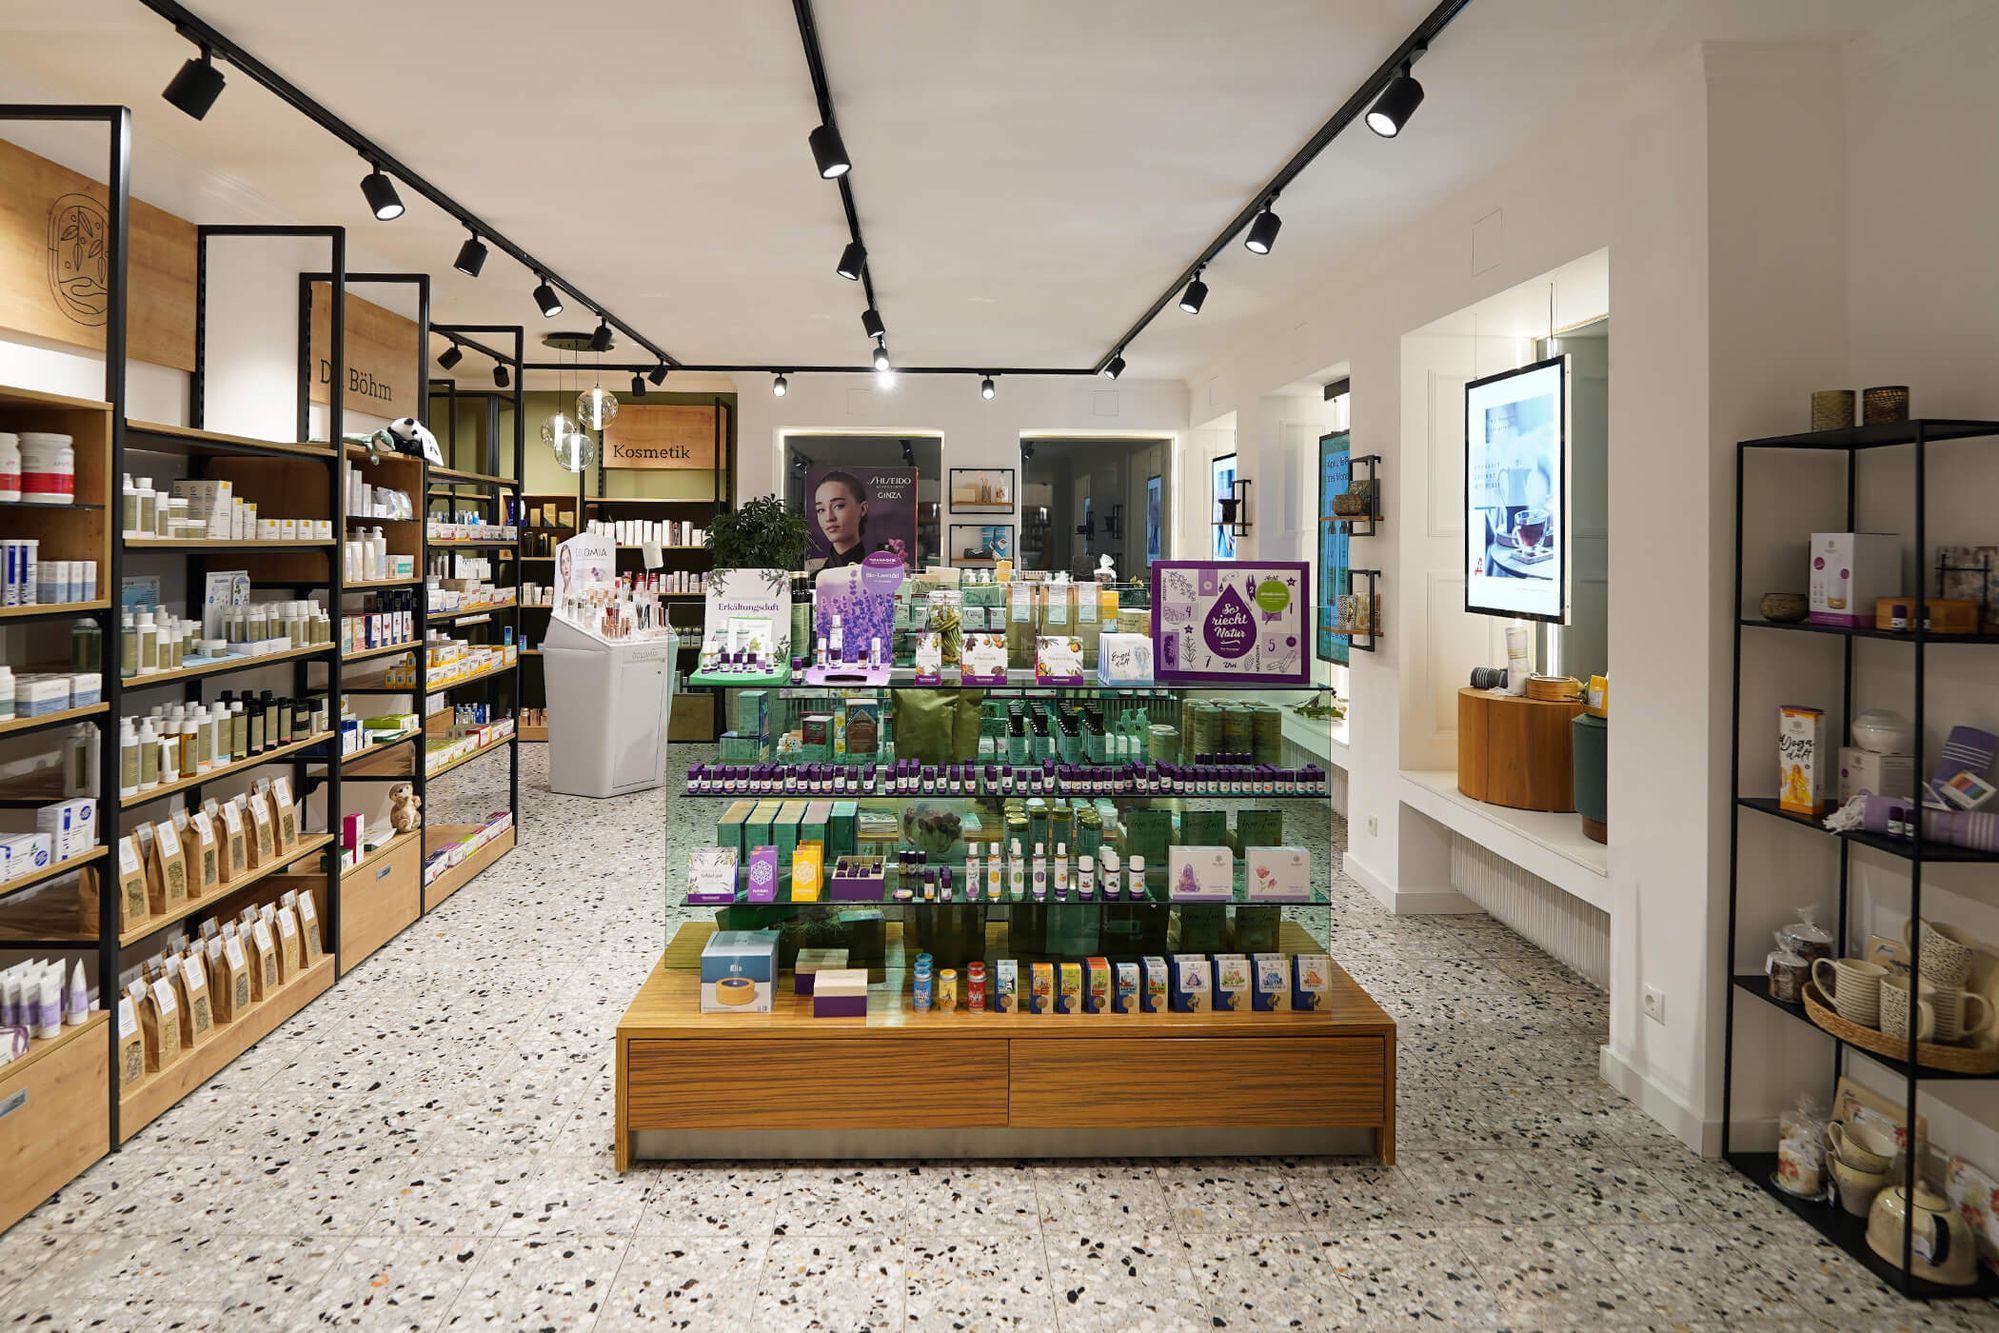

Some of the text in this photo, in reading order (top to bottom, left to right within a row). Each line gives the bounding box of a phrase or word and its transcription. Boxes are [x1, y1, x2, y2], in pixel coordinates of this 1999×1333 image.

[349, 368, 393, 401] Böhm
[613, 444, 691, 459] Kosmetik
[867, 475, 912, 485] SHISEIDO
[877, 491, 902, 499] GINZA
[718, 602, 779, 613] Erkältungsduft
[1185, 605, 1192, 618] 4
[1222, 603, 1239, 615] So
[1212, 613, 1248, 626] riecht
[1214, 626, 1247, 639] Natur
[1268, 639, 1276, 652] 5
[1204, 656, 1212, 668] 7
